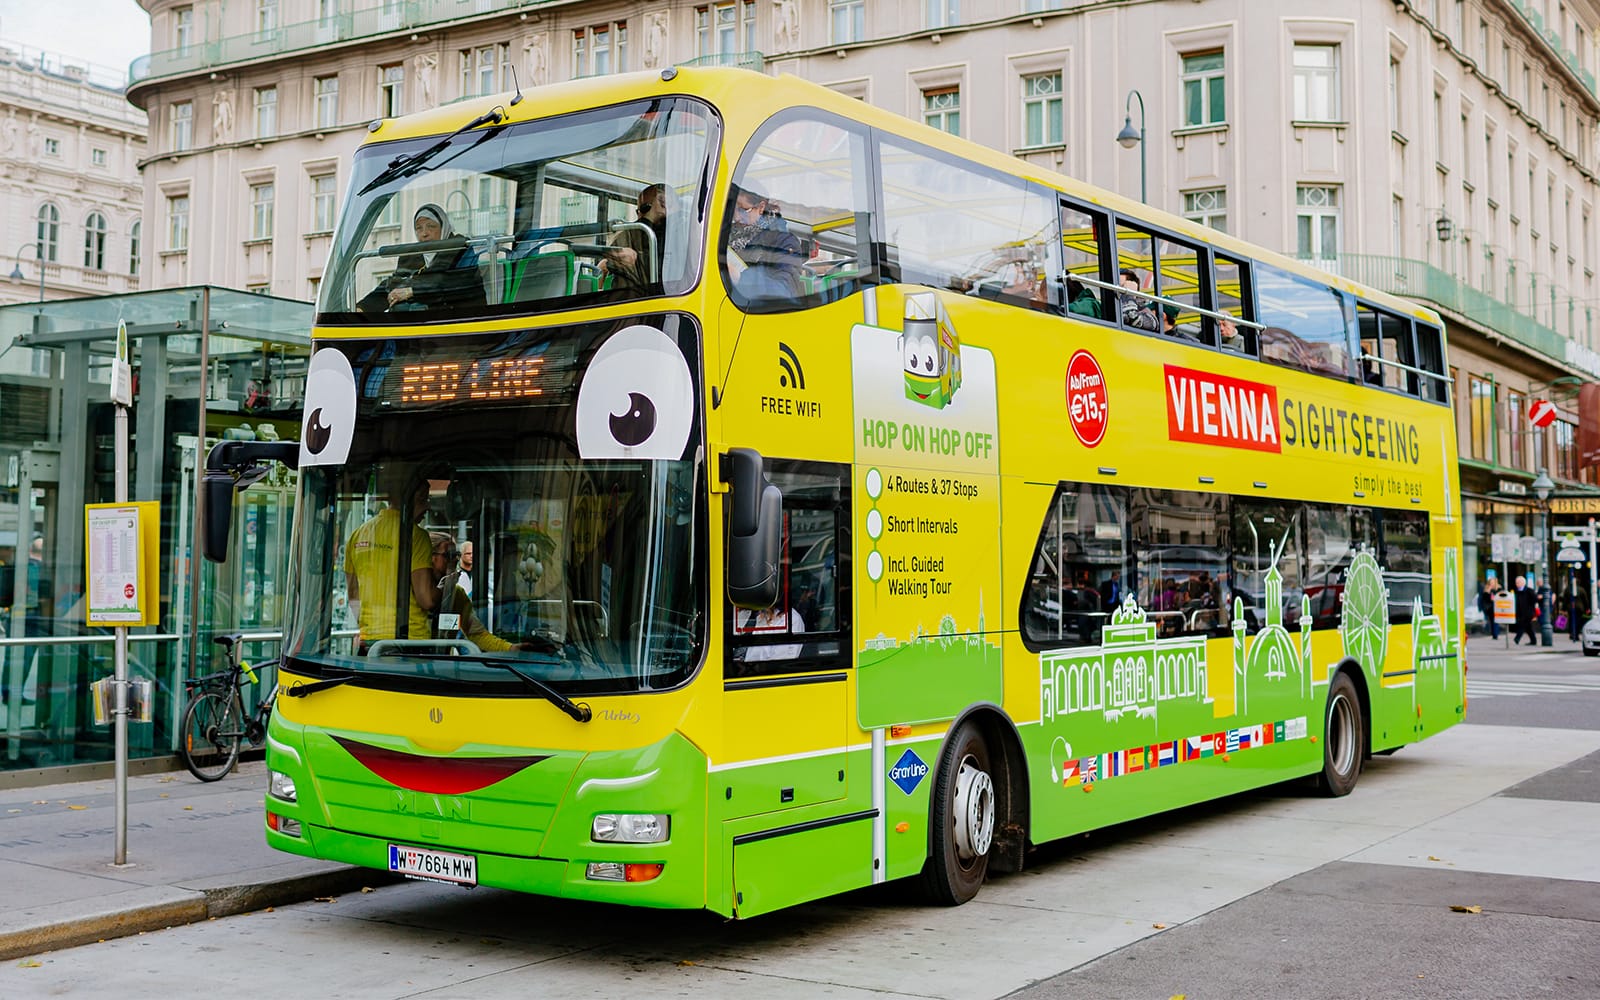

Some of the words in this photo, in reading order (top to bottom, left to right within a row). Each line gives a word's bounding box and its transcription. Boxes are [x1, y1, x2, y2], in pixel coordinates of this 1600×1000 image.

[402, 364, 459, 402] RED
[471, 358, 544, 399] LINE
[1070, 372, 1100, 390] Ab/From
[761, 396, 792, 415] FREE
[795, 399, 821, 418] WIFI
[1168, 374, 1278, 444] VIENNA
[1283, 398, 1419, 465] SIGHTSEEING
[863, 418, 898, 449] HOP
[901, 423, 925, 453] ON
[929, 426, 961, 456] HOP
[964, 431, 993, 459] OFF
[887, 475, 893, 492] 4
[896, 475, 929, 494] Routes
[931, 478, 938, 495] &
[940, 479, 952, 496] 37
[953, 480, 978, 501] Stops
[1354, 472, 1385, 496] simply
[1387, 475, 1401, 495] the
[1404, 478, 1423, 497] best
[887, 515, 915, 533] Short
[917, 516, 958, 534] Intervals
[888, 556, 909, 573] Incl.
[911, 556, 944, 573] Guided
[888, 578, 928, 599] Walking
[929, 578, 952, 595] Tour
[417, 853, 450, 875] 7664
[453, 858, 473, 879] MW
